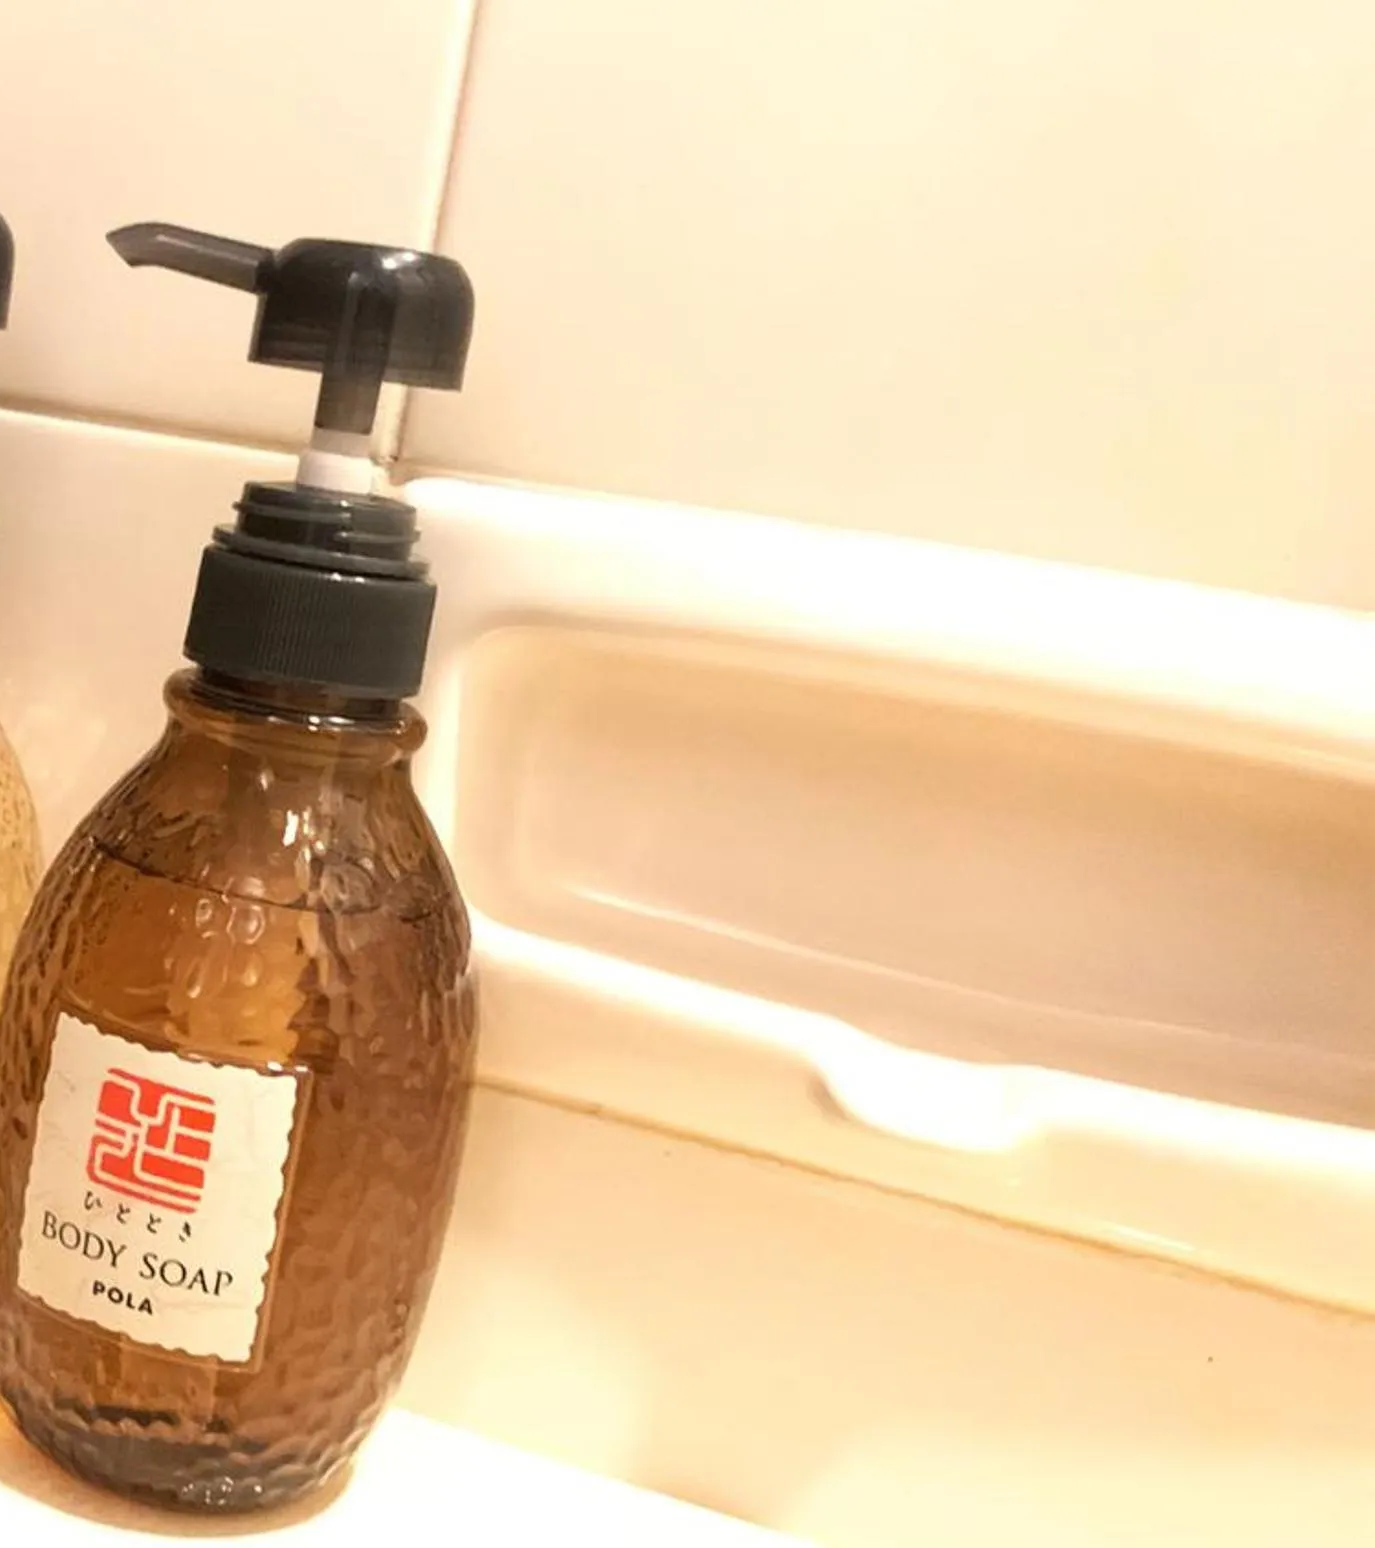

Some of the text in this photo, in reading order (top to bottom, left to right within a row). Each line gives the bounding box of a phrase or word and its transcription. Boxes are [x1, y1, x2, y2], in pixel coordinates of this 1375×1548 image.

[83, 1190, 192, 1242] ひととき
[42, 1210, 234, 1297] BODY SOAP
[92, 1279, 154, 1315] POLA
